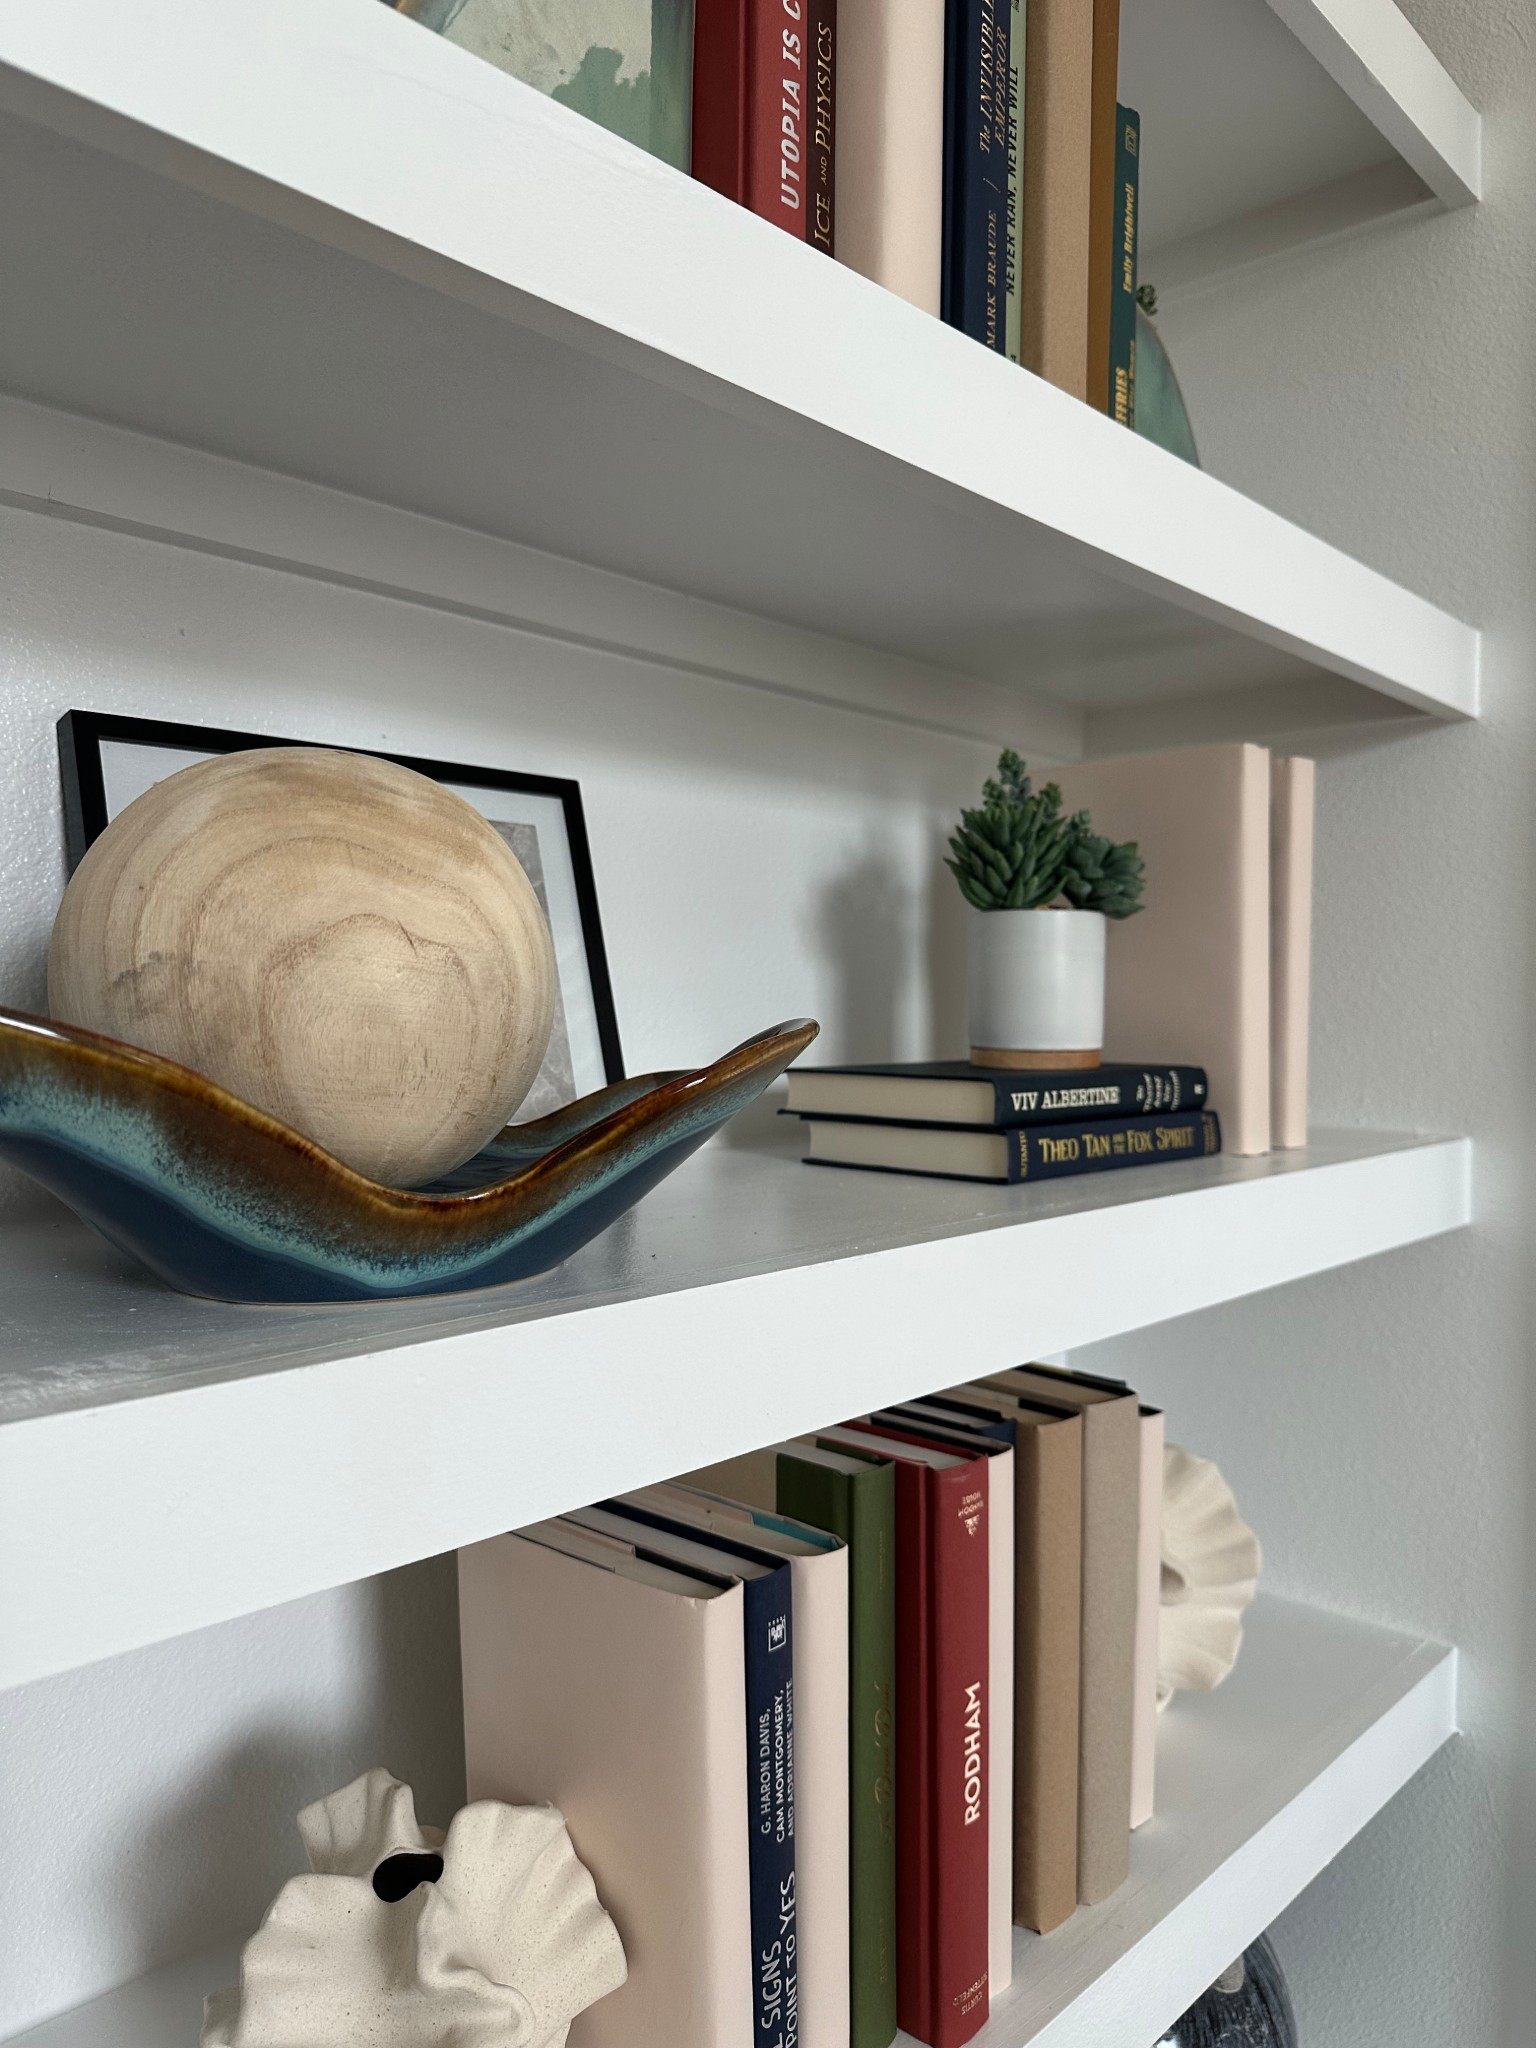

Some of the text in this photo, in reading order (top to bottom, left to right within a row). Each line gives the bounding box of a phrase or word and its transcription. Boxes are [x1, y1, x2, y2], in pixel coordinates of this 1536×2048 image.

[782, 28, 801, 70] IS
[815, 21, 832, 154] PHYSICS
[995, 26, 1007, 150] EMPEROR
[1009, 66, 1018, 111] WILL
[781, 78, 801, 210] UTOPIA
[979, 124, 991, 154] The
[1008, 118, 1018, 179] NEVER
[814, 193, 831, 248] ICE
[1006, 235, 1016, 296] NEVER
[1123, 182, 1134, 294] Emily Brightwell
[986, 209, 998, 348] MARK BRAUDE
[1010, 1091, 1039, 1112] VIV
[1041, 1085, 1121, 1110] ALBERTINE
[1038, 1137, 1080, 1164] THEO
[1082, 1132, 1112, 1159] TAN
[1126, 1129, 1155, 1151] FOX
[1155, 1125, 1195, 1149] SPIRIT
[760, 1707, 771, 1834] G. HARON DAVIS,
[774, 1689, 785, 1843] CAM MONTGOMERY,
[786, 1677, 795, 1837] AND ADRIANNE WHITE
[964, 1681, 982, 1827] RODHAM
[761, 1940, 783, 2029] SIGNS
[779, 1870, 798, 2048] POINT TO YES
[961, 1991, 983, 2016] CURTIS
